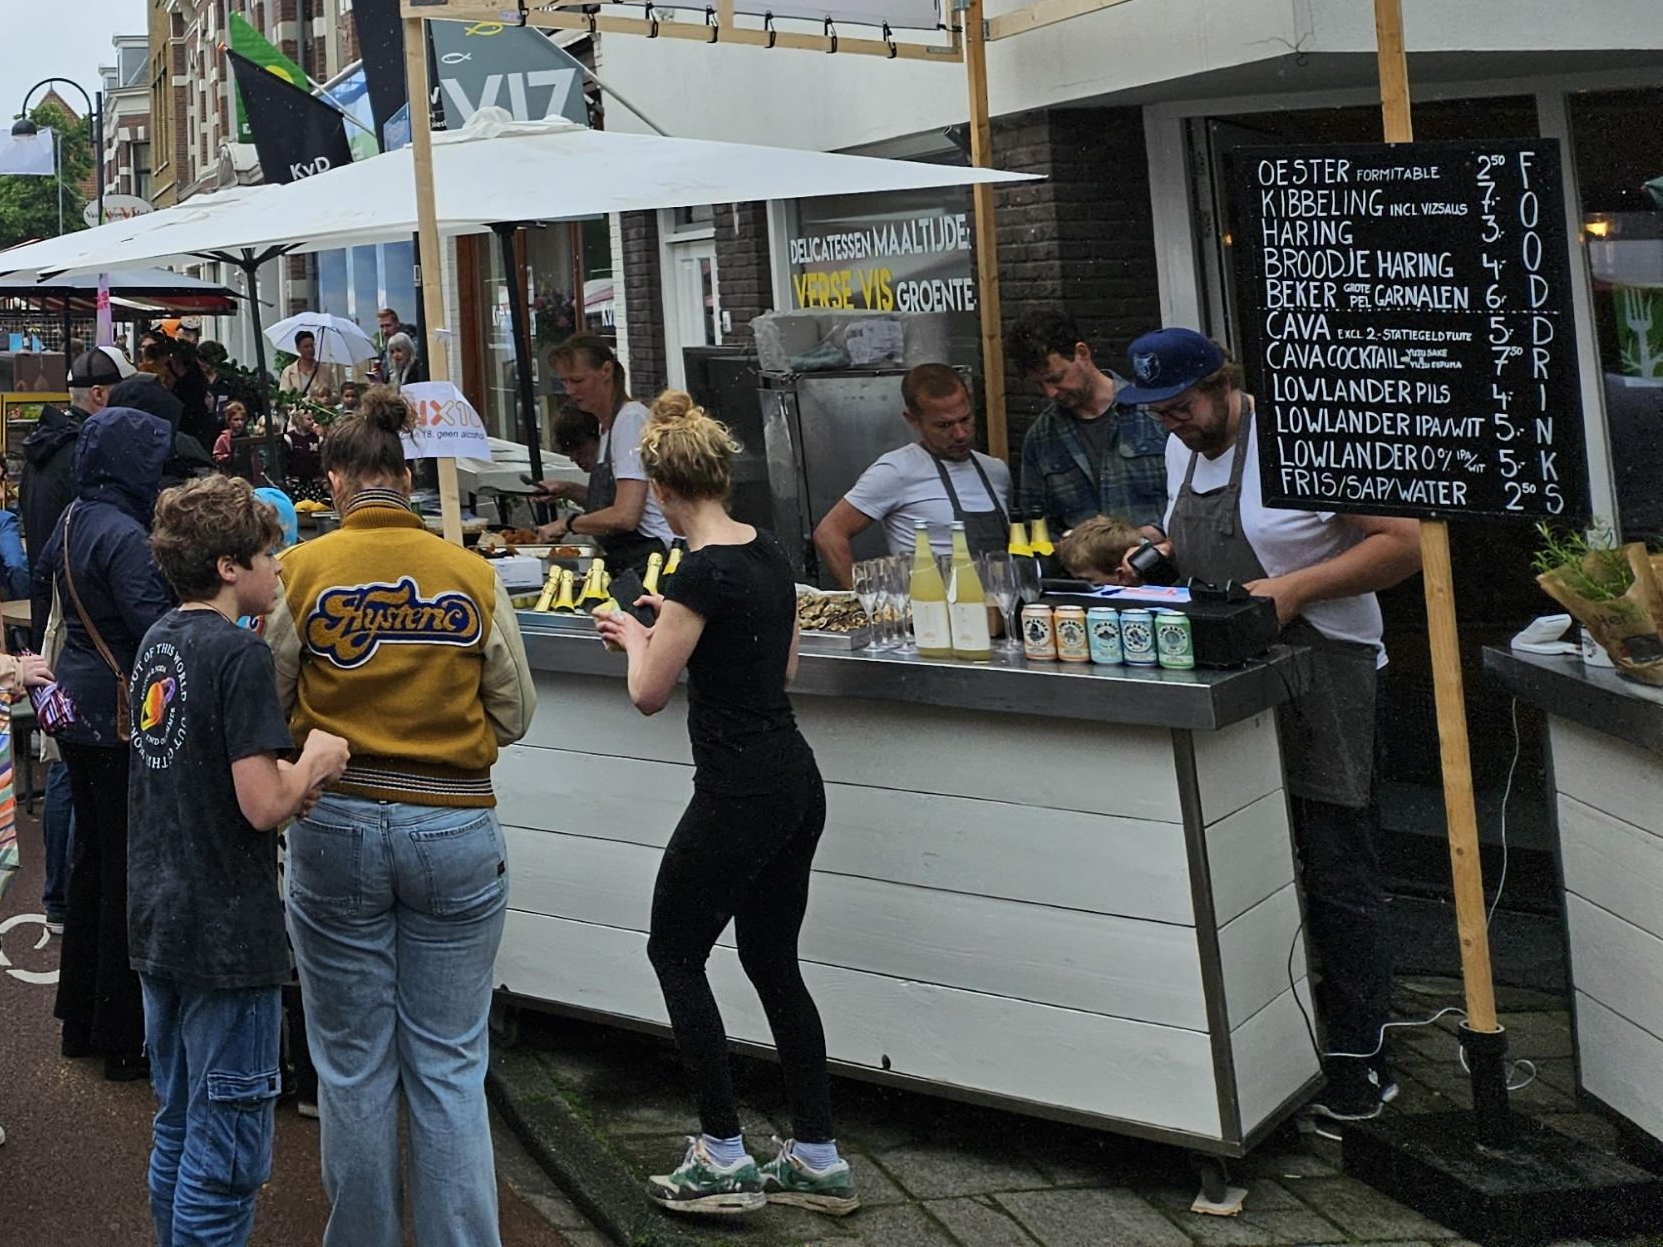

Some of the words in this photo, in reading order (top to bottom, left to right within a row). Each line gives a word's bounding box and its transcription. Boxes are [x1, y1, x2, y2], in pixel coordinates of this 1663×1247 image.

[1258, 159, 1351, 186] OESTER
[1356, 166, 1440, 182] FORMITABLE
[1261, 189, 1384, 218] KIBBELING
[1421, 202, 1468, 216] VIZSAUS
[789, 231, 872, 265] DELICATESSEN
[872, 213, 971, 258] MAALTIJDE
[1262, 219, 1353, 247] HARING
[1264, 248, 1371, 279] BROODJE
[1378, 252, 1454, 278] HARING
[792, 269, 855, 310] VERSE
[858, 267, 895, 312] VIS
[896, 277, 977, 312] GROENTE
[1266, 281, 1337, 309] BEKER
[1374, 285, 1468, 309] GARNALEN
[1266, 311, 1331, 341] CAVA
[1266, 345, 1324, 370] CAVA
[1328, 345, 1405, 370] COCKTAIL
[1273, 373, 1415, 402] LOWLANDER
[1416, 383, 1451, 403] PILS
[1276, 405, 1409, 435] LOWLANDER
[1277, 436, 1418, 471] LOWLANDER
[1281, 469, 1468, 506] FRIS/SAP/WATER
[308, 583, 478, 661] Hysteric
[143, 646, 155, 663] OF
[156, 642, 175, 657] THIS
[173, 650, 188, 702] WORLD
